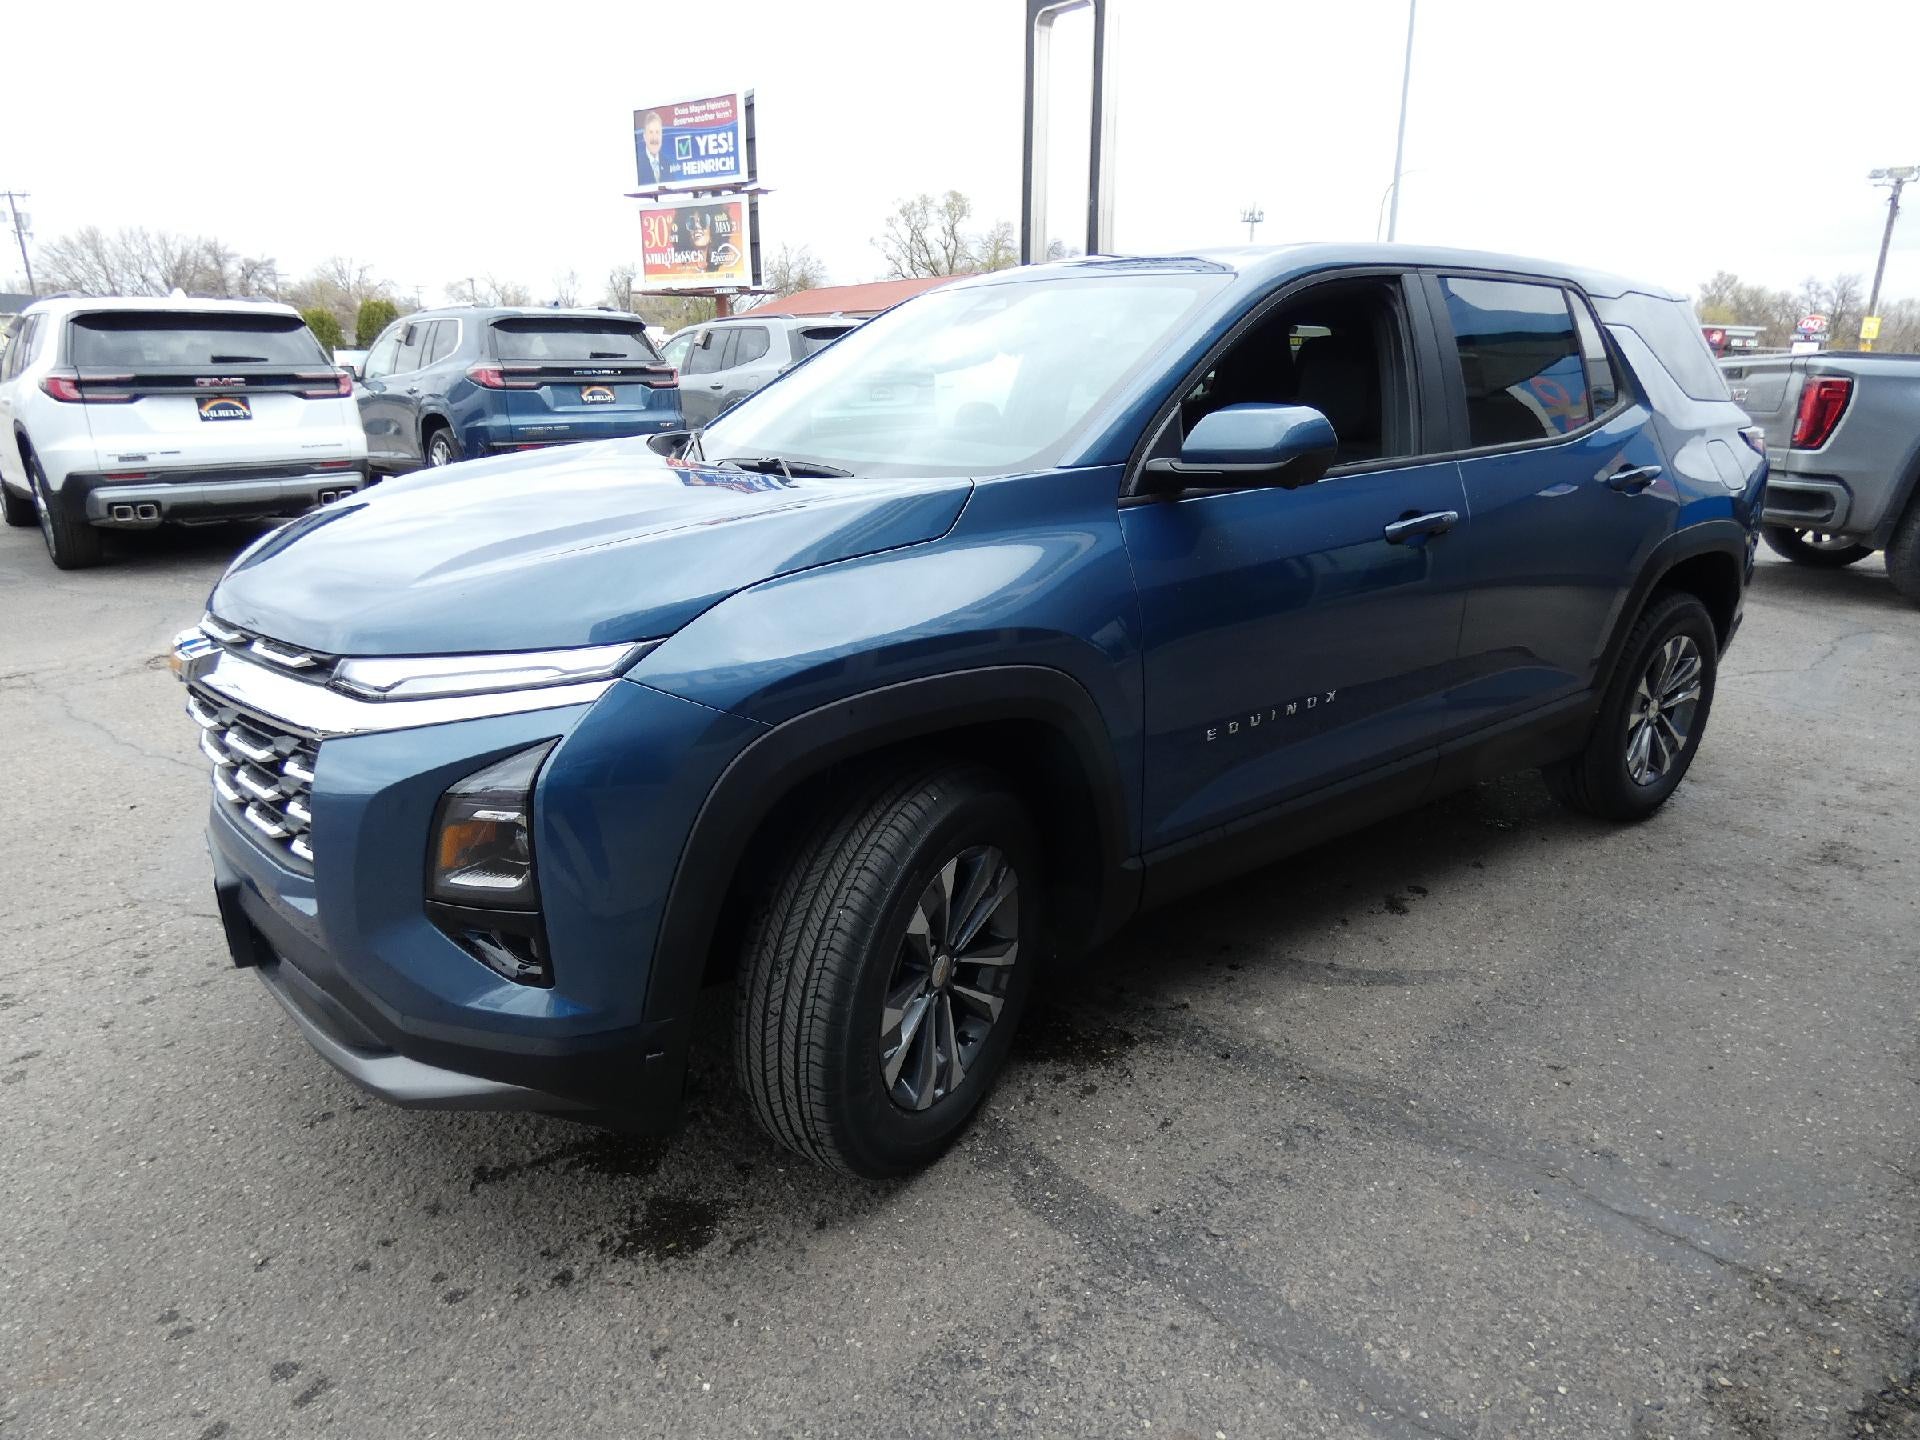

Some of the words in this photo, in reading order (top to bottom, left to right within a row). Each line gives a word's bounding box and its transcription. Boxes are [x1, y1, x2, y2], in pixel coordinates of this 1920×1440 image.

[706, 100, 730, 110] Heinrich
[695, 131, 734, 156] YES!
[682, 157, 735, 175] HEINRICH
[645, 247, 704, 269] sunglasses
[1802, 319, 1821, 331] DQ
[195, 377, 246, 387] GMC
[1206, 689, 1338, 742] EQUINOX
